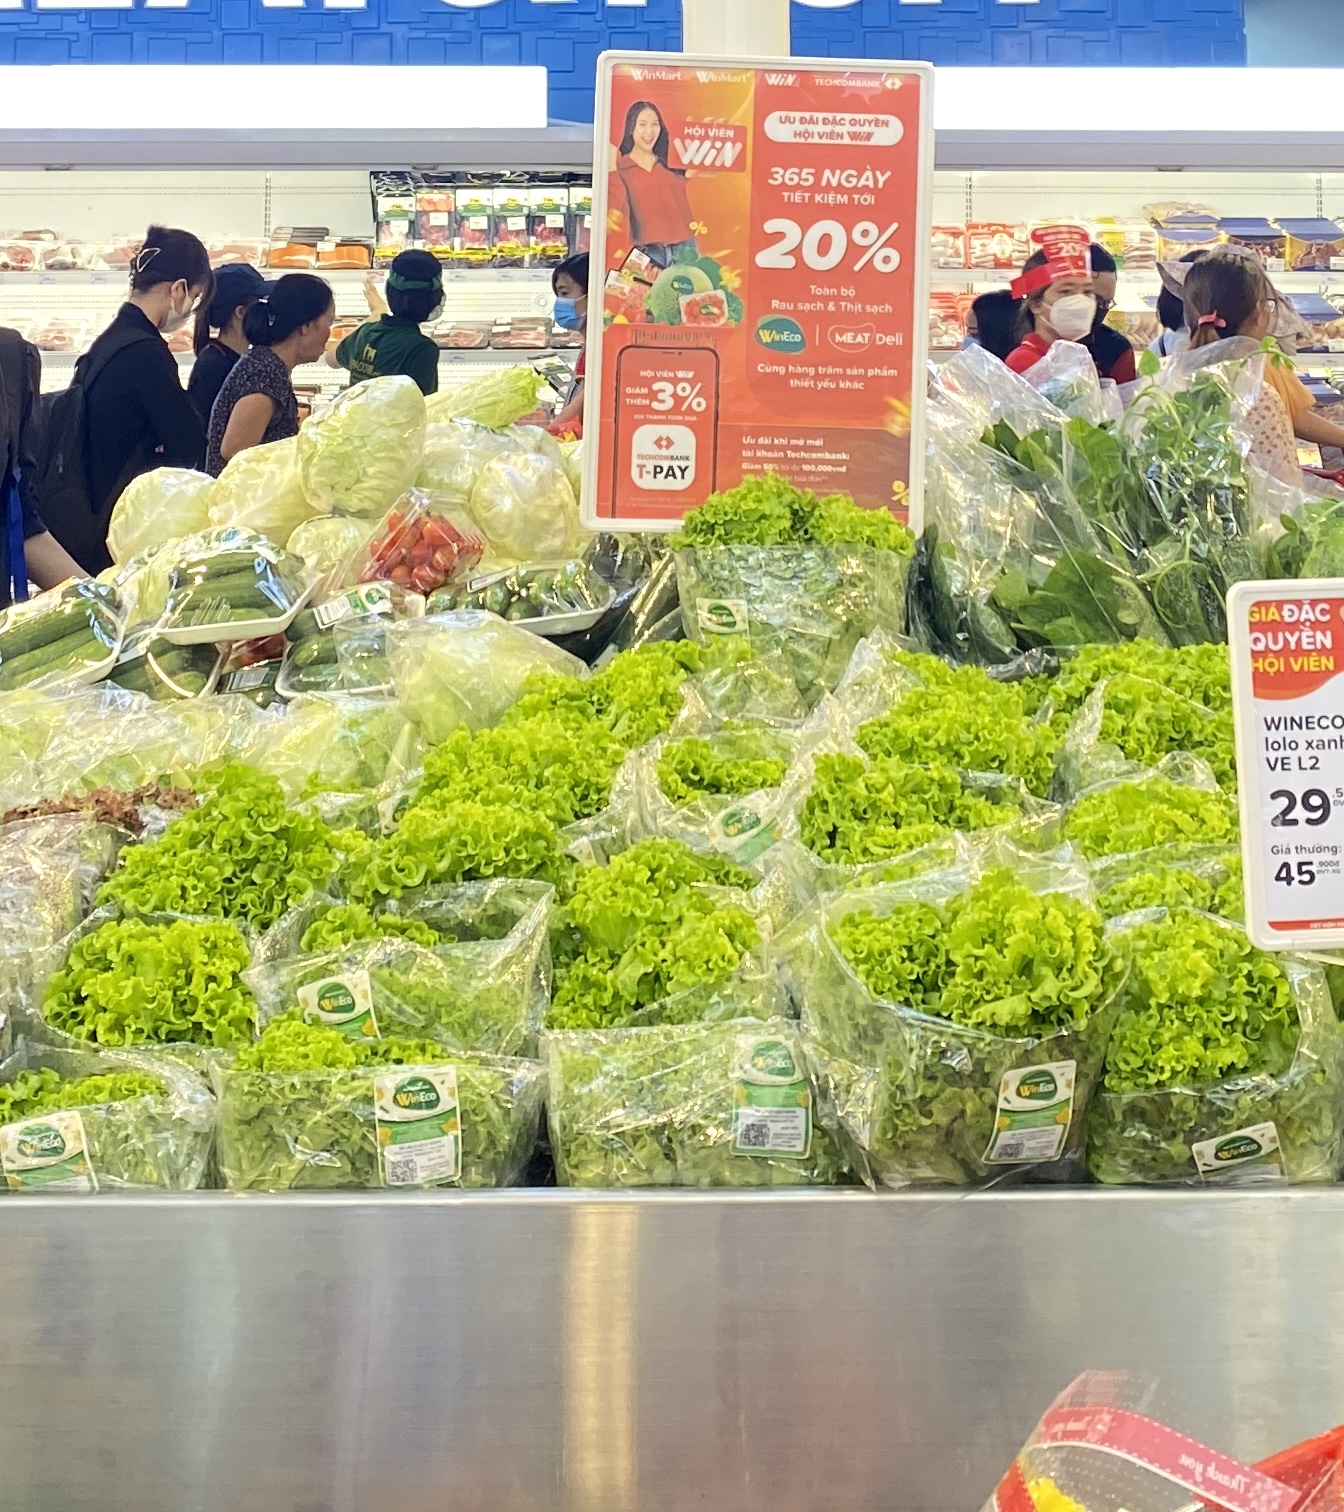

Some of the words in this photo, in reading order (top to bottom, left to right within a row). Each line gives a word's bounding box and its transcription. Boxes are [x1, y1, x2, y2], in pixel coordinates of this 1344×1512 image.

[814, 78, 882, 89] TECHCOMBANK
[778, 115, 797, 126] ƯU
[798, 114, 819, 126] ĐÃI
[822, 115, 845, 129] ĐẶC
[848, 115, 890, 129] QUYỀN
[684, 126, 705, 139] HỘI
[707, 125, 735, 138] VIÊN
[793, 130, 812, 142] HỘI
[814, 129, 844, 141] VIÊN
[767, 167, 815, 188] 365
[821, 164, 892, 190] NGÀY
[782, 190, 810, 206] TIẾT
[813, 190, 849, 207] KIỆM
[852, 190, 876, 206] TỚI
[755, 218, 902, 274] 20%
[809, 285, 837, 296] Toàn
[840, 285, 856, 298] bộ
[771, 300, 794, 311] Rau
[797, 300, 824, 313] sạch
[827, 302, 836, 312] &
[840, 302, 862, 314] Thịt
[865, 303, 893, 315] sạch
[759, 328, 802, 343] WinEco
[835, 332, 871, 344] MEAT
[875, 332, 903, 346] Deli
[640, 370, 655, 379] HỘI
[656, 370, 674, 378] VIÊN
[757, 364, 786, 375] Cùng
[788, 364, 816, 376] hàng
[818, 365, 843, 375] trăm
[846, 365, 865, 376] sản
[867, 365, 898, 377] phẩm
[626, 386, 648, 395] GIẢM
[790, 378, 814, 388] thiết
[817, 379, 836, 390] yếu
[839, 380, 865, 390] khác
[626, 397, 650, 406] THÊM
[651, 381, 707, 412] 3%
[773, 437, 788, 445] khi
[637, 454, 690, 462] TECHCOMBANK
[636, 464, 690, 481] T-PAY
[1249, 602, 1280, 622] GIÁ
[1282, 600, 1331, 626] ĐẶC
[1250, 624, 1332, 652] QUYỀN
[1252, 653, 1285, 676] HỘI
[1289, 652, 1334, 672] VIÊN
[1265, 736, 1299, 752] lolo
[1266, 757, 1292, 772] VE
[1298, 756, 1320, 771] L2
[1270, 788, 1331, 827] 29
[1271, 843, 1291, 855] Giá
[1295, 843, 1342, 856] thường:
[1275, 861, 1316, 886] 45
[1019, 1082, 1056, 1097] WinEco
[396, 1091, 437, 1107] WinEco
[1217, 1143, 1258, 1160] WinEco
